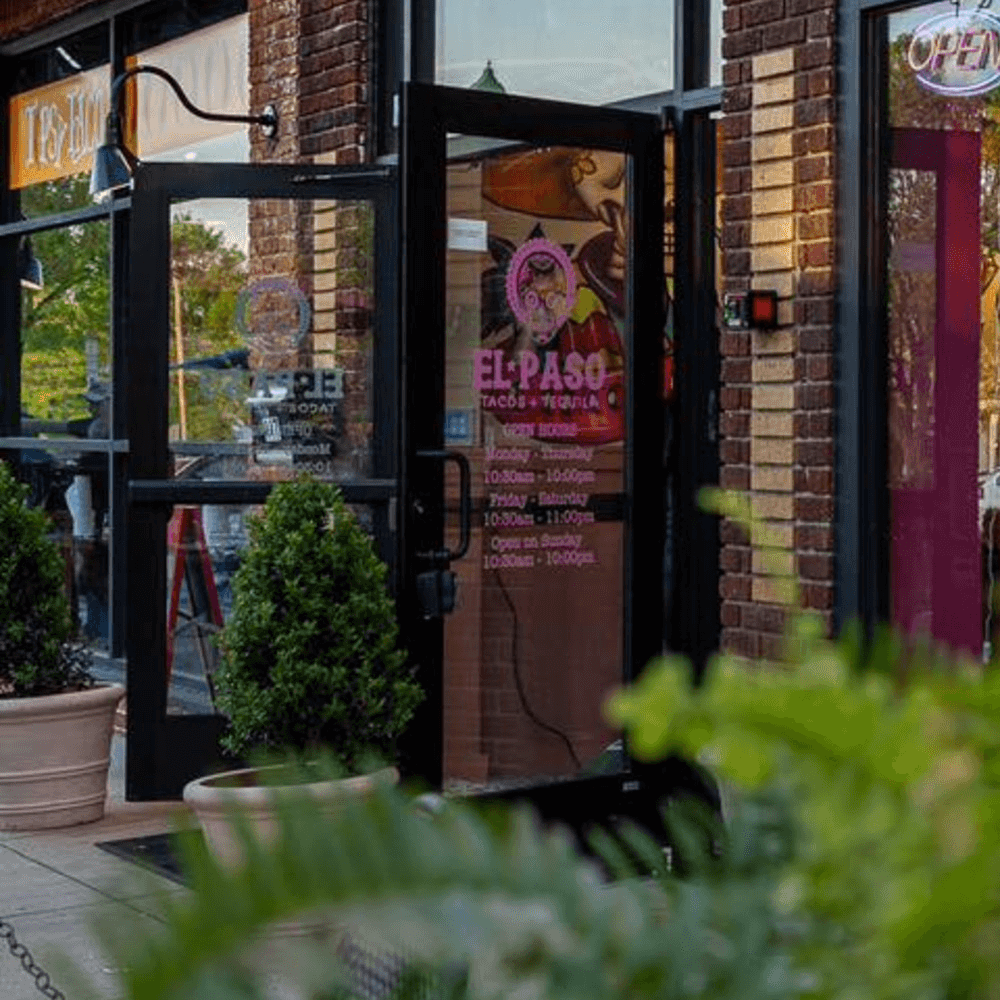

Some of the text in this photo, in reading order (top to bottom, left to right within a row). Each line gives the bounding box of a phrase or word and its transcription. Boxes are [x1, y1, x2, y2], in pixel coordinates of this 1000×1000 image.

[474, 349, 608, 390] EL PASO
[482, 394, 526, 409] TACOS
[541, 394, 600, 409] TEQUILA
[490, 492, 528, 509] Friday
[546, 510, 595, 526] 11:00pm
[491, 535, 522, 552] Open
